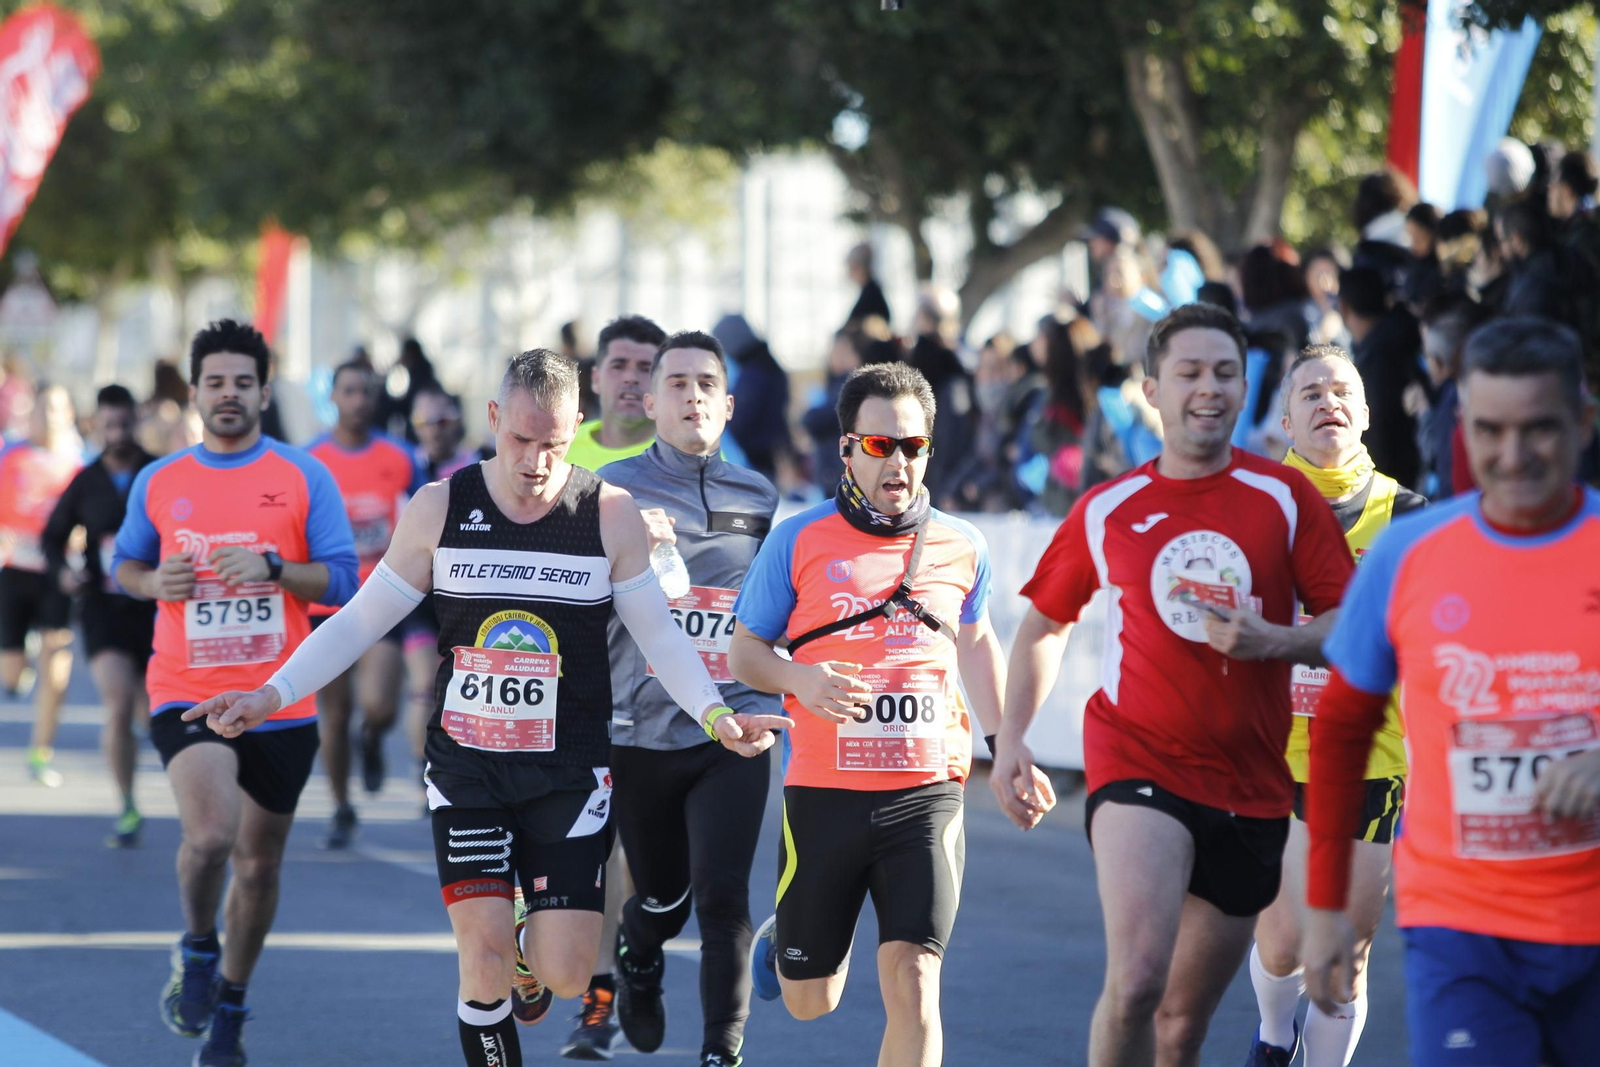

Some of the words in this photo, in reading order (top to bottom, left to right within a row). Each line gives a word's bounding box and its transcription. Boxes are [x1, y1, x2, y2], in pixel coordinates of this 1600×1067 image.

[459, 523, 492, 532] VIATOR
[1163, 534, 1240, 567] MARISCOS
[449, 563, 536, 580] ATLETISMO
[538, 567, 591, 586] SERON
[196, 598, 272, 626] 5795
[1171, 611, 1200, 626] RE
[504, 664, 550, 673] SALUDABLE
[513, 657, 550, 665] CARRERA
[1301, 671, 1331, 681] GABRI
[460, 673, 544, 706] 6166
[480, 705, 515, 715] JUANLU
[480, 1033, 501, 1067] SPORT
